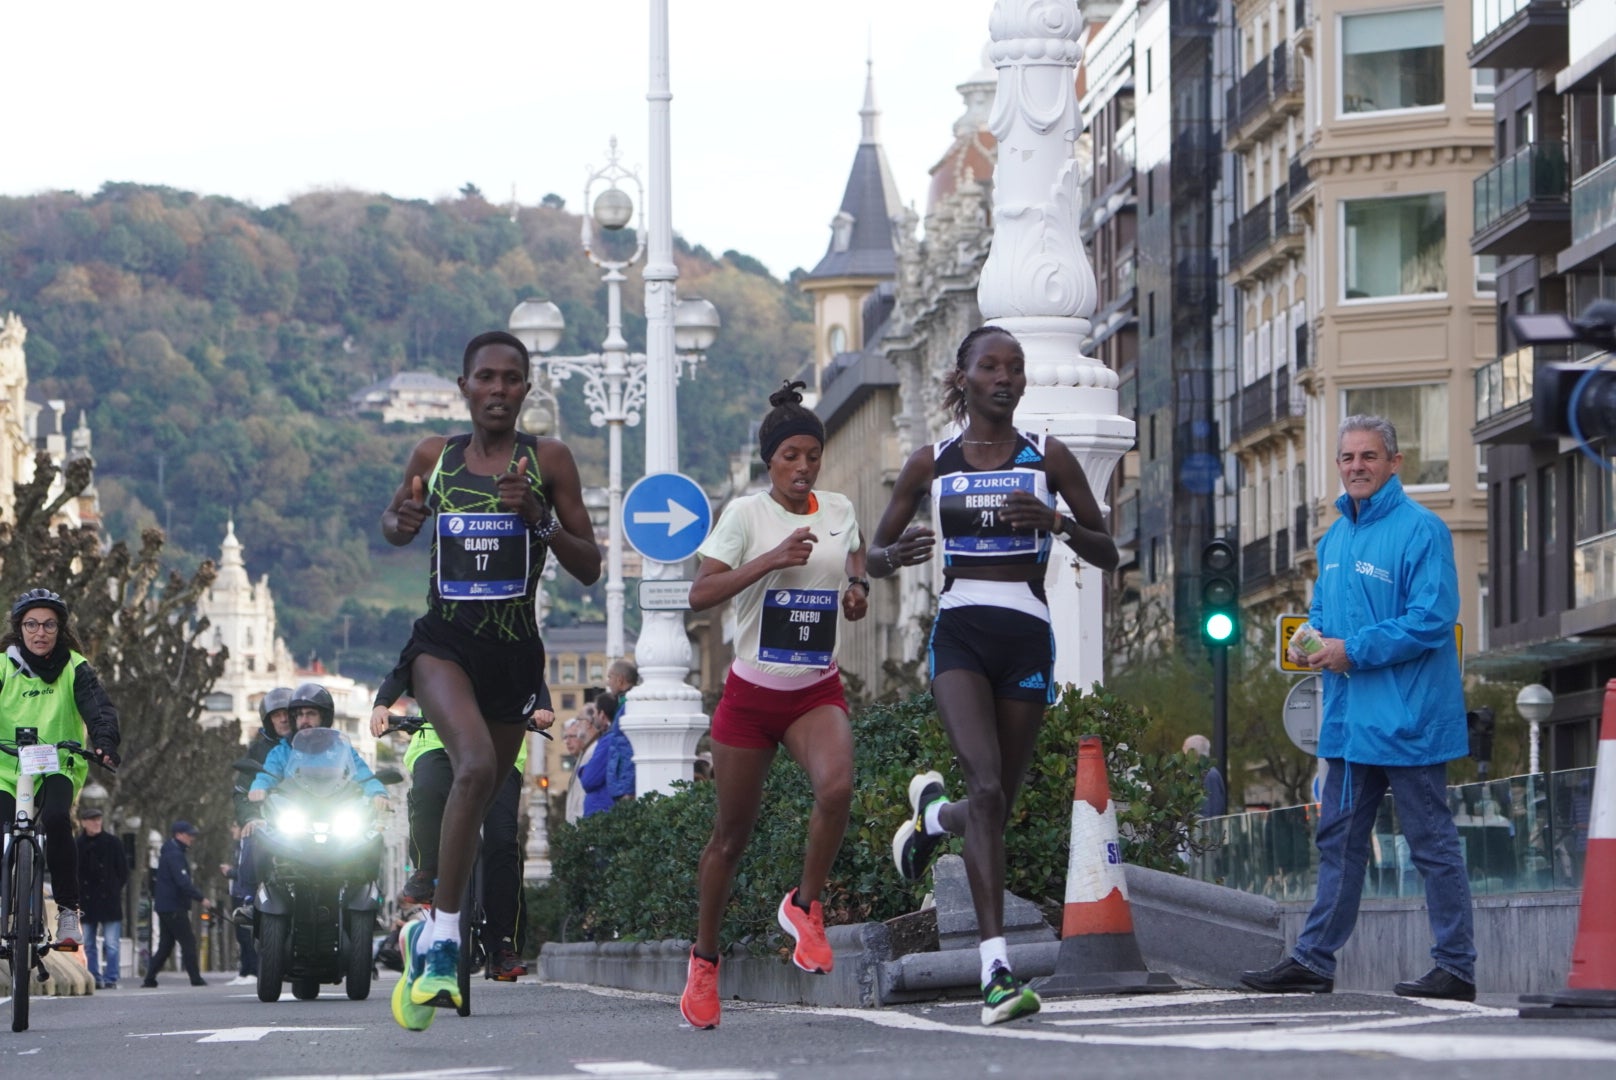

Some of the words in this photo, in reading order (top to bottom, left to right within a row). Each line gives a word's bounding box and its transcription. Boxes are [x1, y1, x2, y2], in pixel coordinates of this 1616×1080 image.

[1014, 456, 1042, 465] adidas
[973, 477, 1020, 488] ZURICH
[468, 520, 514, 531] ZURICH
[981, 511, 995, 528] 21
[464, 537, 500, 551] GLADYS
[474, 554, 489, 572] 17
[794, 594, 832, 605] ZURICH
[789, 610, 821, 623] ZENEBU
[798, 625, 811, 642] 19
